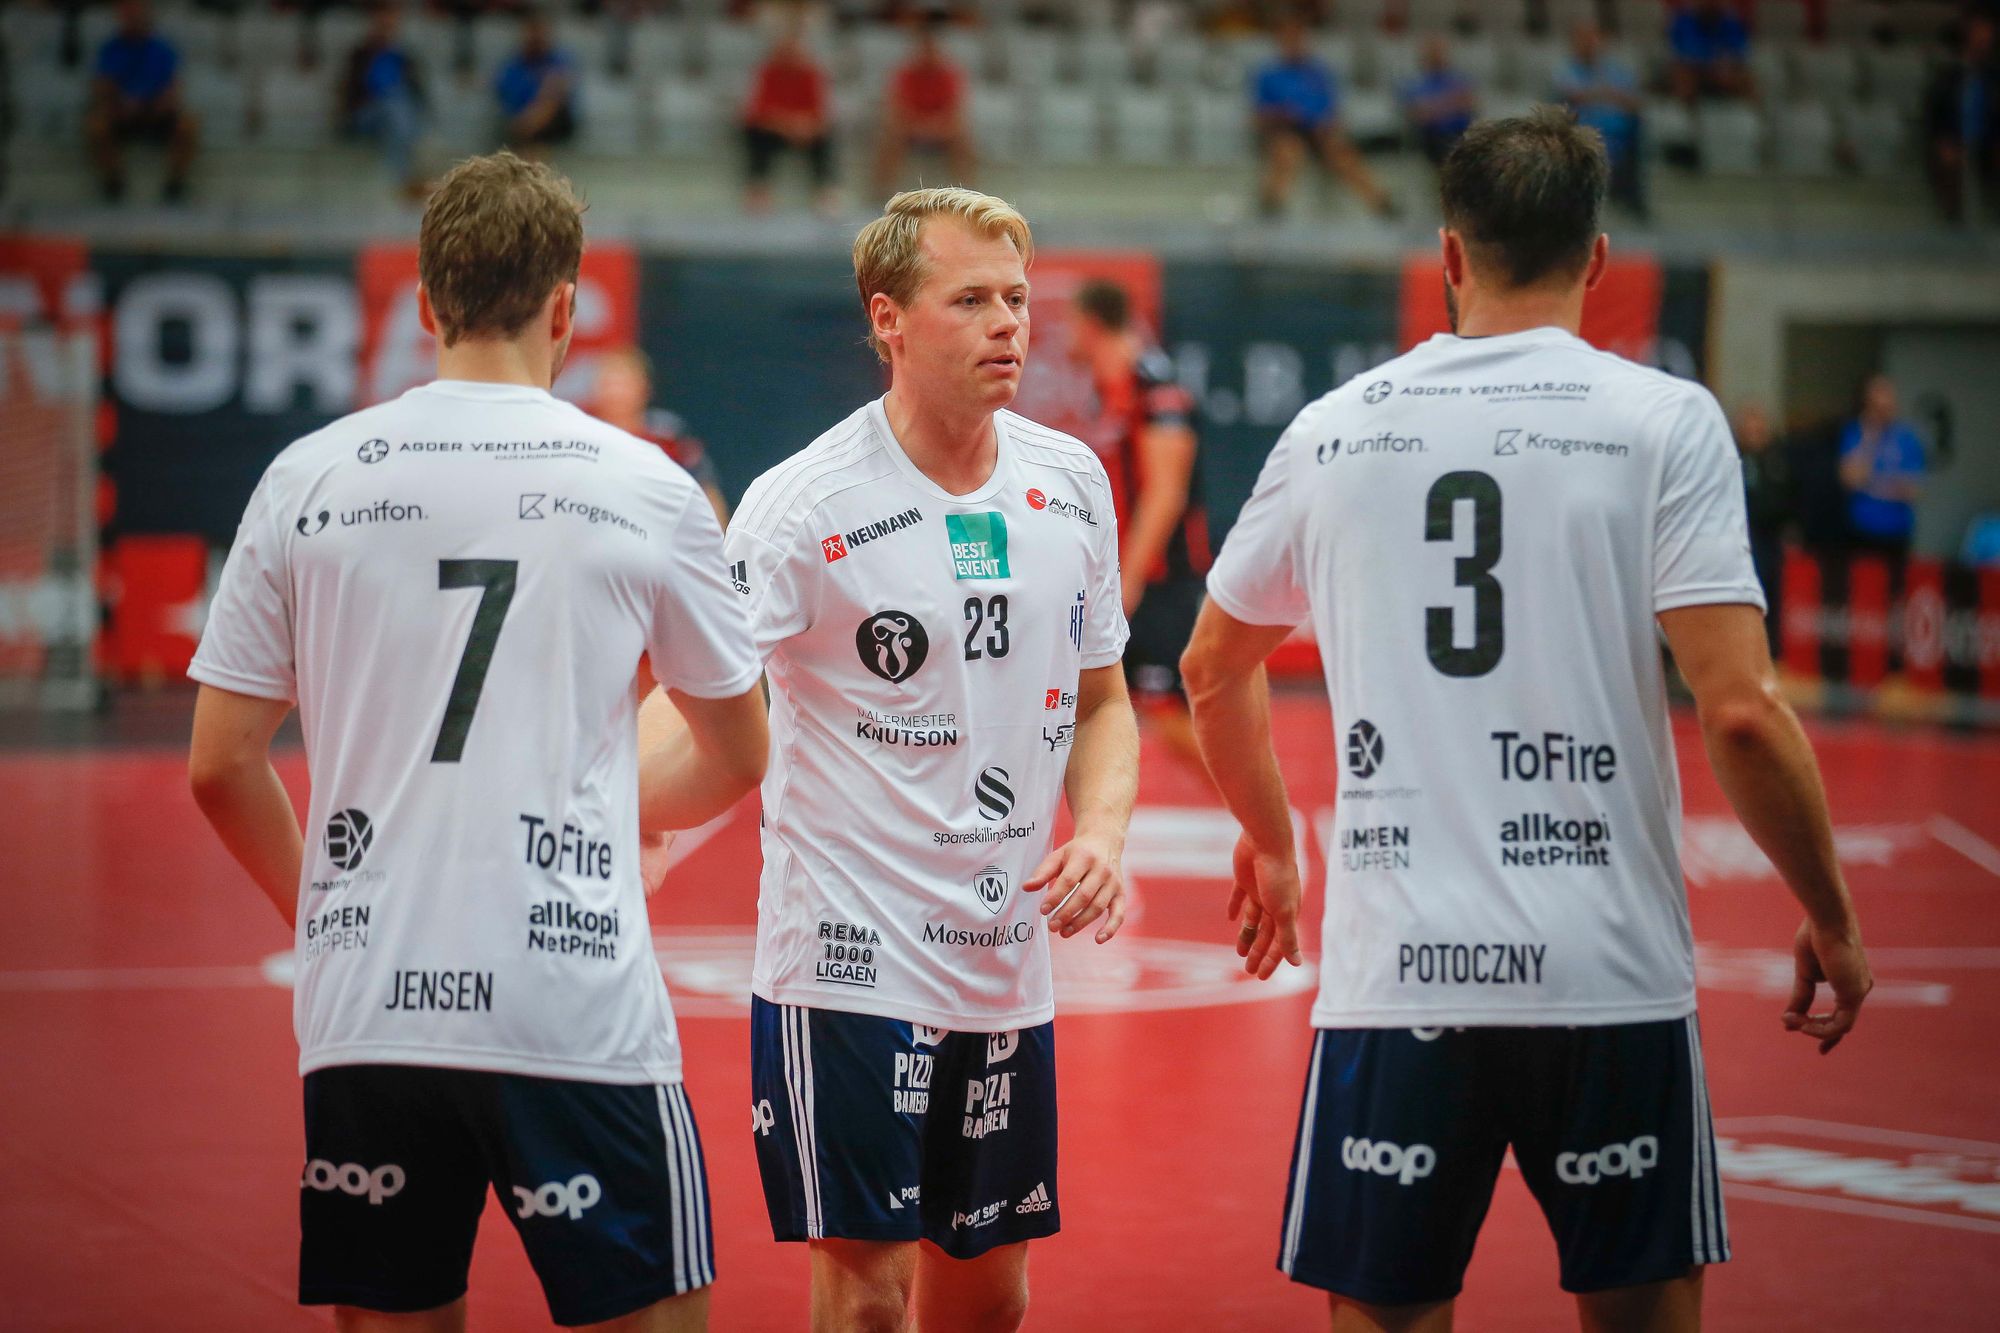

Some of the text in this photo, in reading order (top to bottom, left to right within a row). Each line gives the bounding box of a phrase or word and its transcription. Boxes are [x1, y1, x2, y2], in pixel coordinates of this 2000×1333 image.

[1400, 382, 1592, 396] AGDER VENTILASJON
[400, 440, 600, 456] AGDER VENTILASJON
[1526, 431, 1629, 459] Krogsveen
[553, 497, 648, 540] Krogsveen
[1048, 497, 1098, 526] AVITEL
[846, 507, 923, 549] NEUMANN
[953, 542, 988, 559] BEST
[956, 558, 1000, 577] EVENT
[1425, 470, 1504, 678] 3
[964, 594, 1009, 661] 23
[431, 559, 518, 763] 7
[856, 722, 957, 747] KNUTSON
[1491, 731, 1617, 784] ToFire
[1500, 813, 1611, 846] allkopi
[520, 814, 612, 881] ToFire
[1502, 846, 1610, 867] NetPrint
[529, 900, 619, 940] allkopi
[818, 920, 882, 946] REMA
[528, 929, 617, 960] NetPrint
[823, 942, 874, 965] 1000
[816, 961, 877, 983] LIGAEN
[1399, 943, 1547, 984] POTOCZNY
[386, 970, 493, 1012] JENSEN
[962, 1108, 1009, 1139] BAEREN
[1556, 1135, 1658, 1185] coop
[300, 1158, 406, 1205] oop
[1015, 1200, 1052, 1214] adidas
